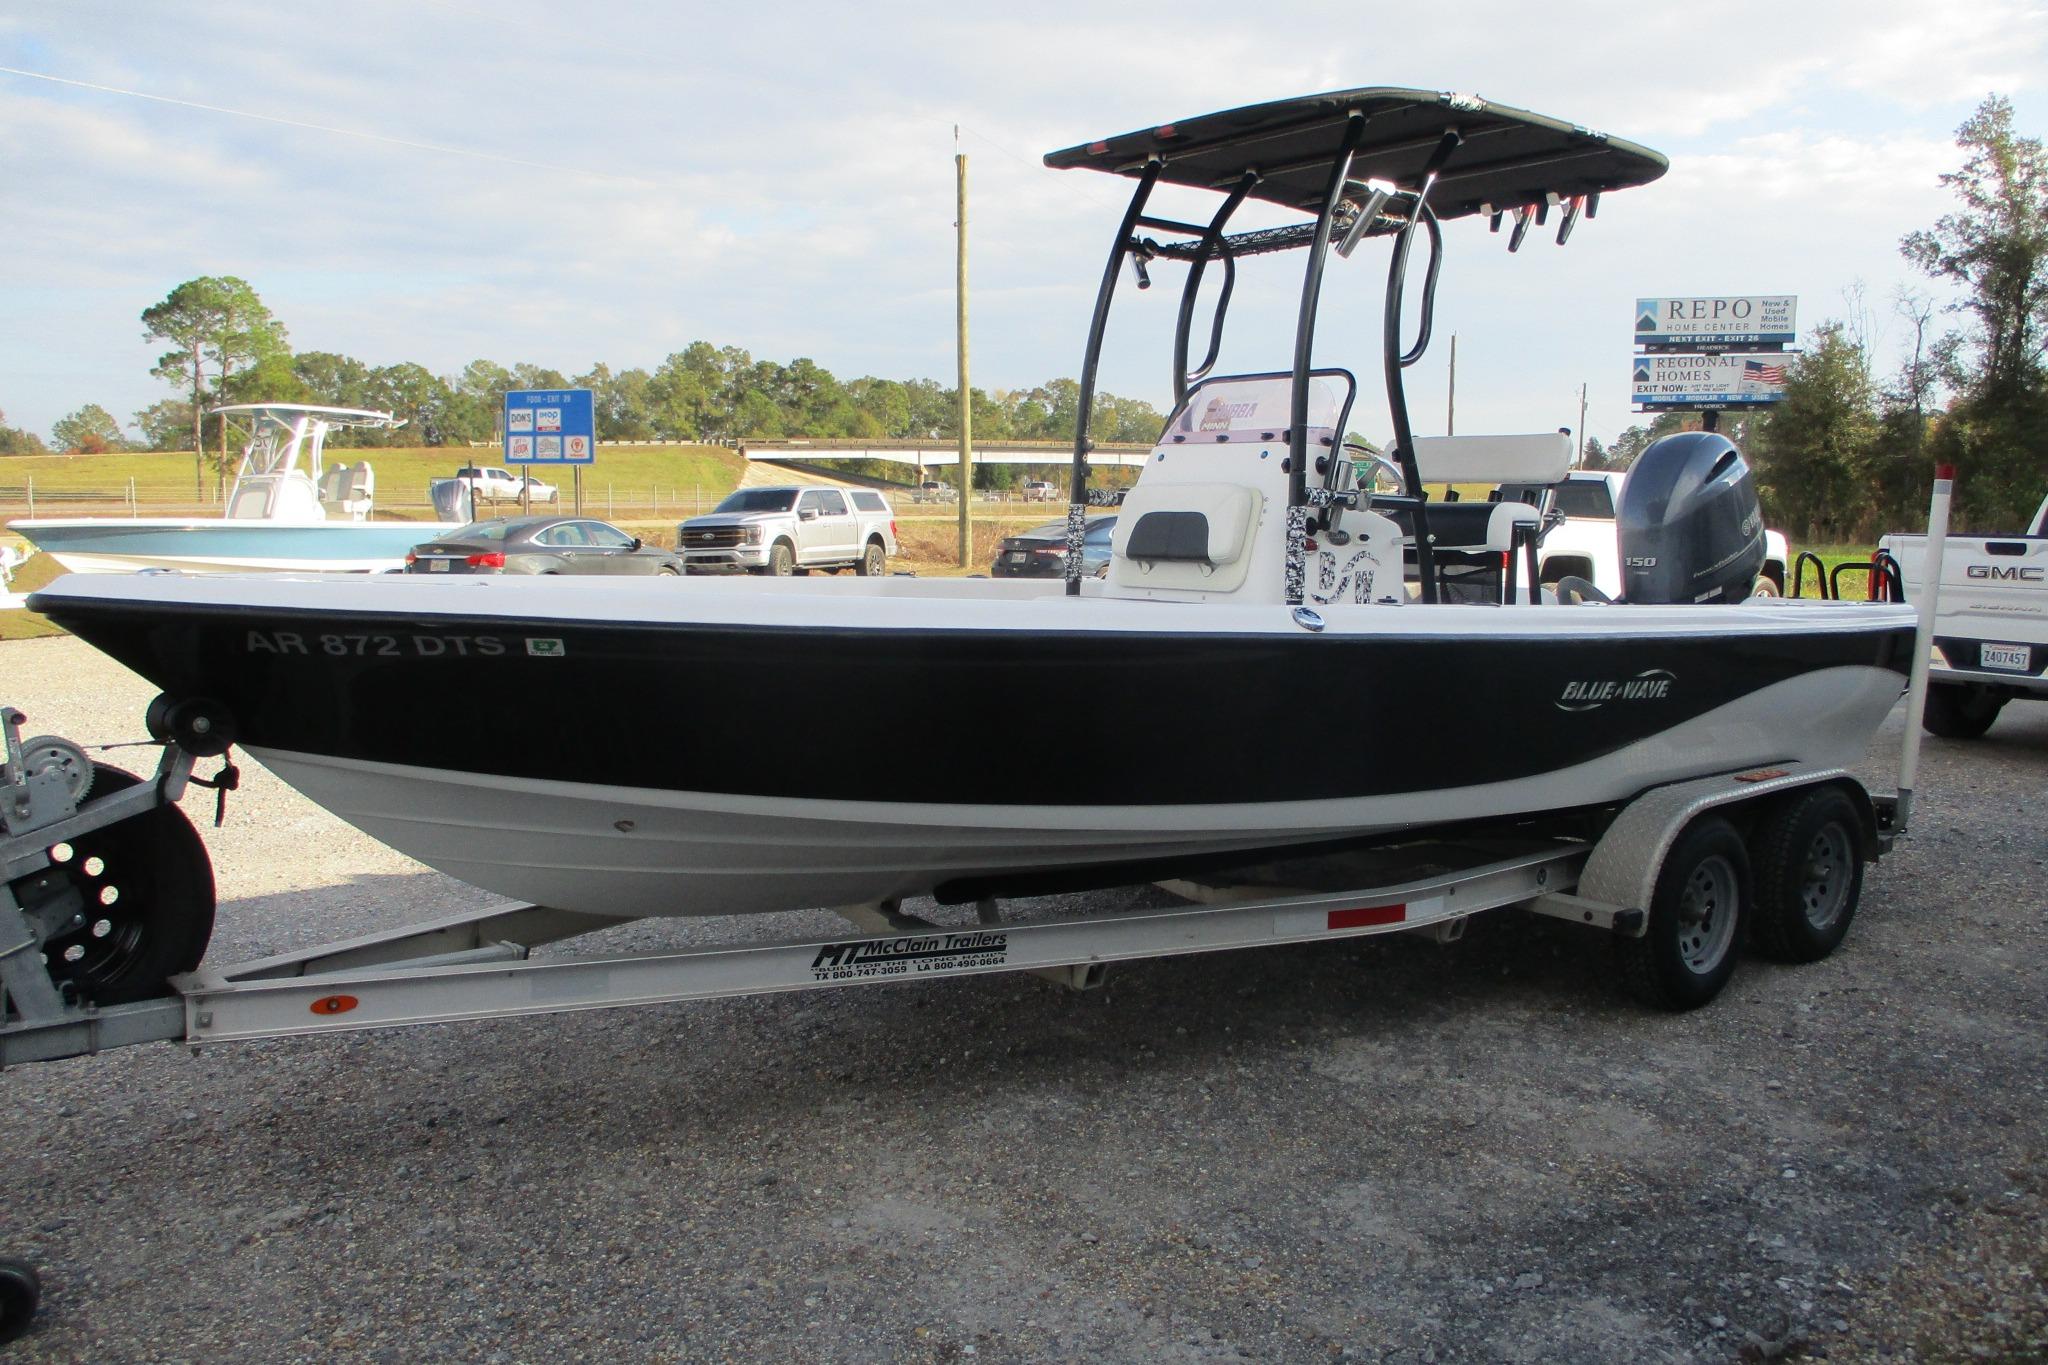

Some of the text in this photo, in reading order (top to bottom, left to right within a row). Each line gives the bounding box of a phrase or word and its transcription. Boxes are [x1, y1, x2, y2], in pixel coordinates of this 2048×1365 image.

[1668, 299, 1752, 319] REPO
[1666, 323, 1750, 331] HOME CENTER
[1657, 356, 1740, 369] REGIONAL
[1656, 370, 1711, 382] HOMES
[1637, 385, 1658, 393] EXIT
[1625, 557, 1657, 567] 150
[1967, 565, 2044, 581] GMC
[247, 630, 506, 656] AR 872 DTS
[1561, 680, 1672, 700] BLUE WAVE
[863, 932, 1008, 956] McClain Trailers
[815, 972, 830, 981] TX
[917, 964, 931, 972] LA
